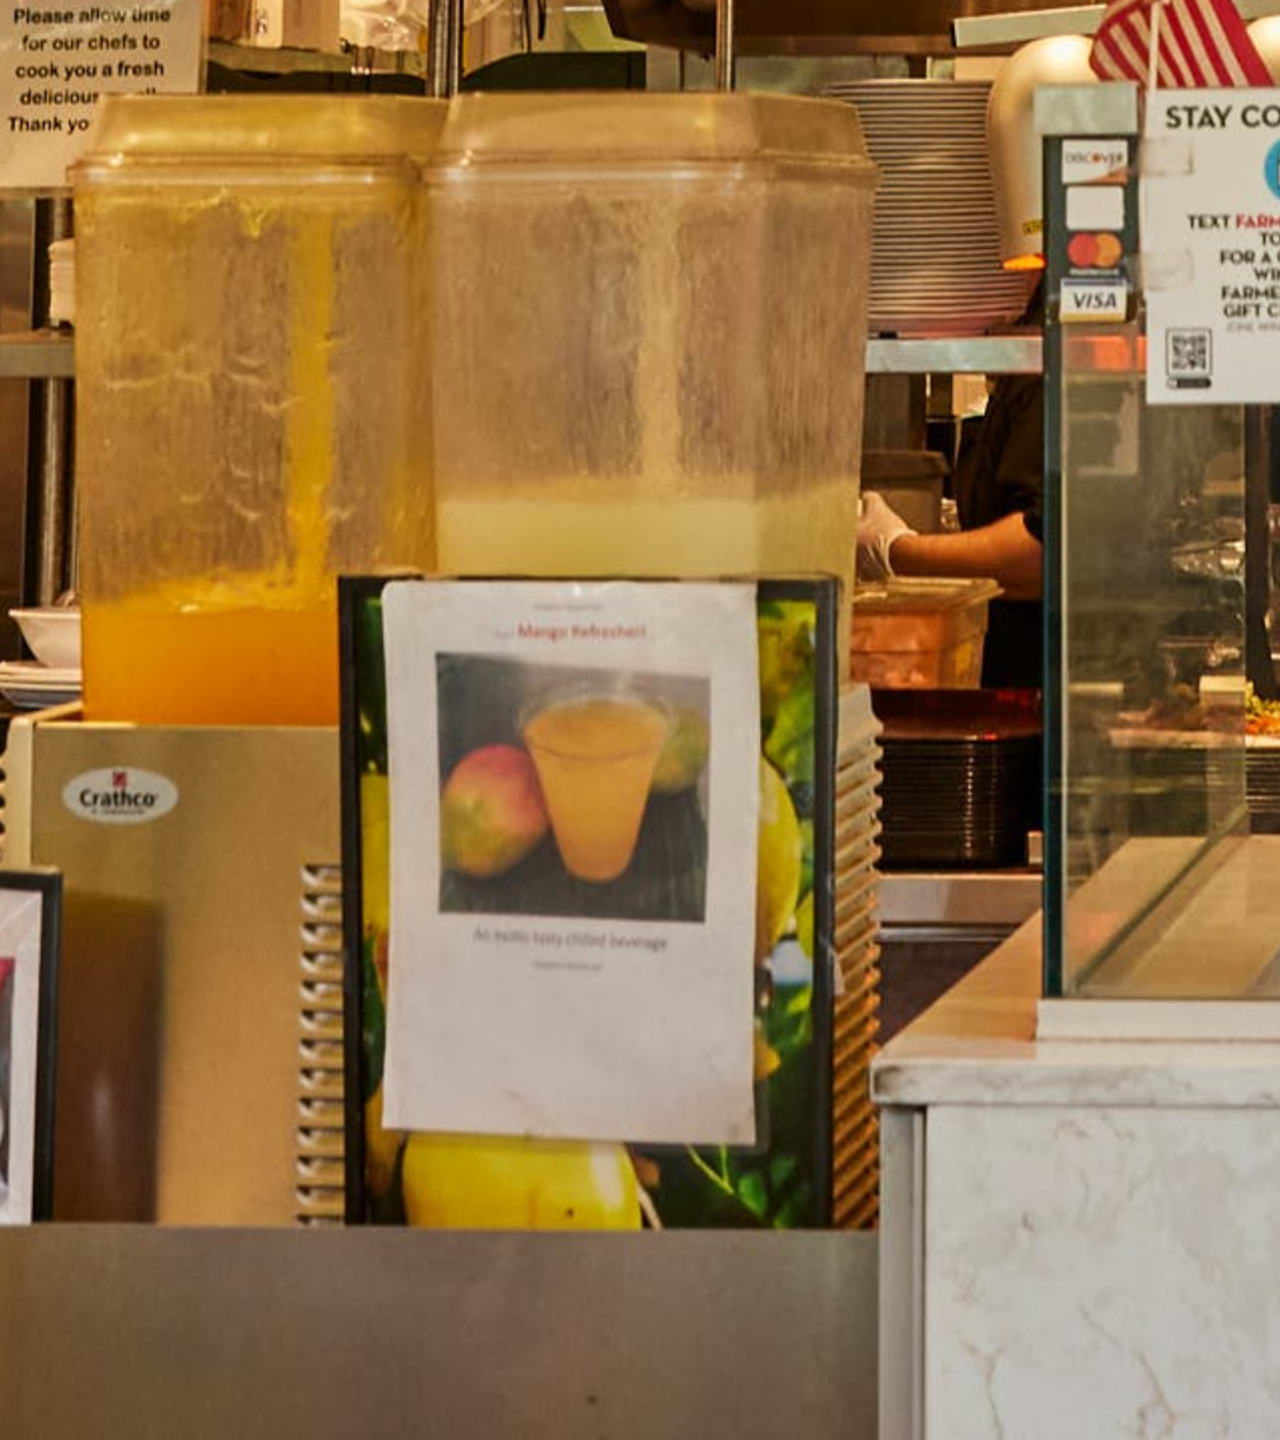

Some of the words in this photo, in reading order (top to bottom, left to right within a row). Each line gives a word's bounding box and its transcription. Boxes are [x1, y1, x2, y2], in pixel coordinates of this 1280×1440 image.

[14, 8, 73, 25] Please
[22, 36, 49, 51] for
[52, 38, 83, 51] our
[88, 35, 137, 51] chefs
[143, 35, 160, 50] to
[15, 62, 59, 79] cook
[64, 66, 97, 82] you
[102, 65, 112, 77] a
[116, 61, 164, 77] fresh
[8, 116, 62, 132] Thank
[67, 118, 90, 135] yo
[1165, 106, 1233, 130] STAY
[1186, 215, 1231, 229] TEXT
[1219, 251, 1256, 265] FOR
[1260, 251, 1272, 264] A
[1074, 292, 1118, 309] VISA
[1223, 303, 1261, 318] GIFT
[518, 621, 568, 642] Mango
[80, 789, 156, 807] Crathco
